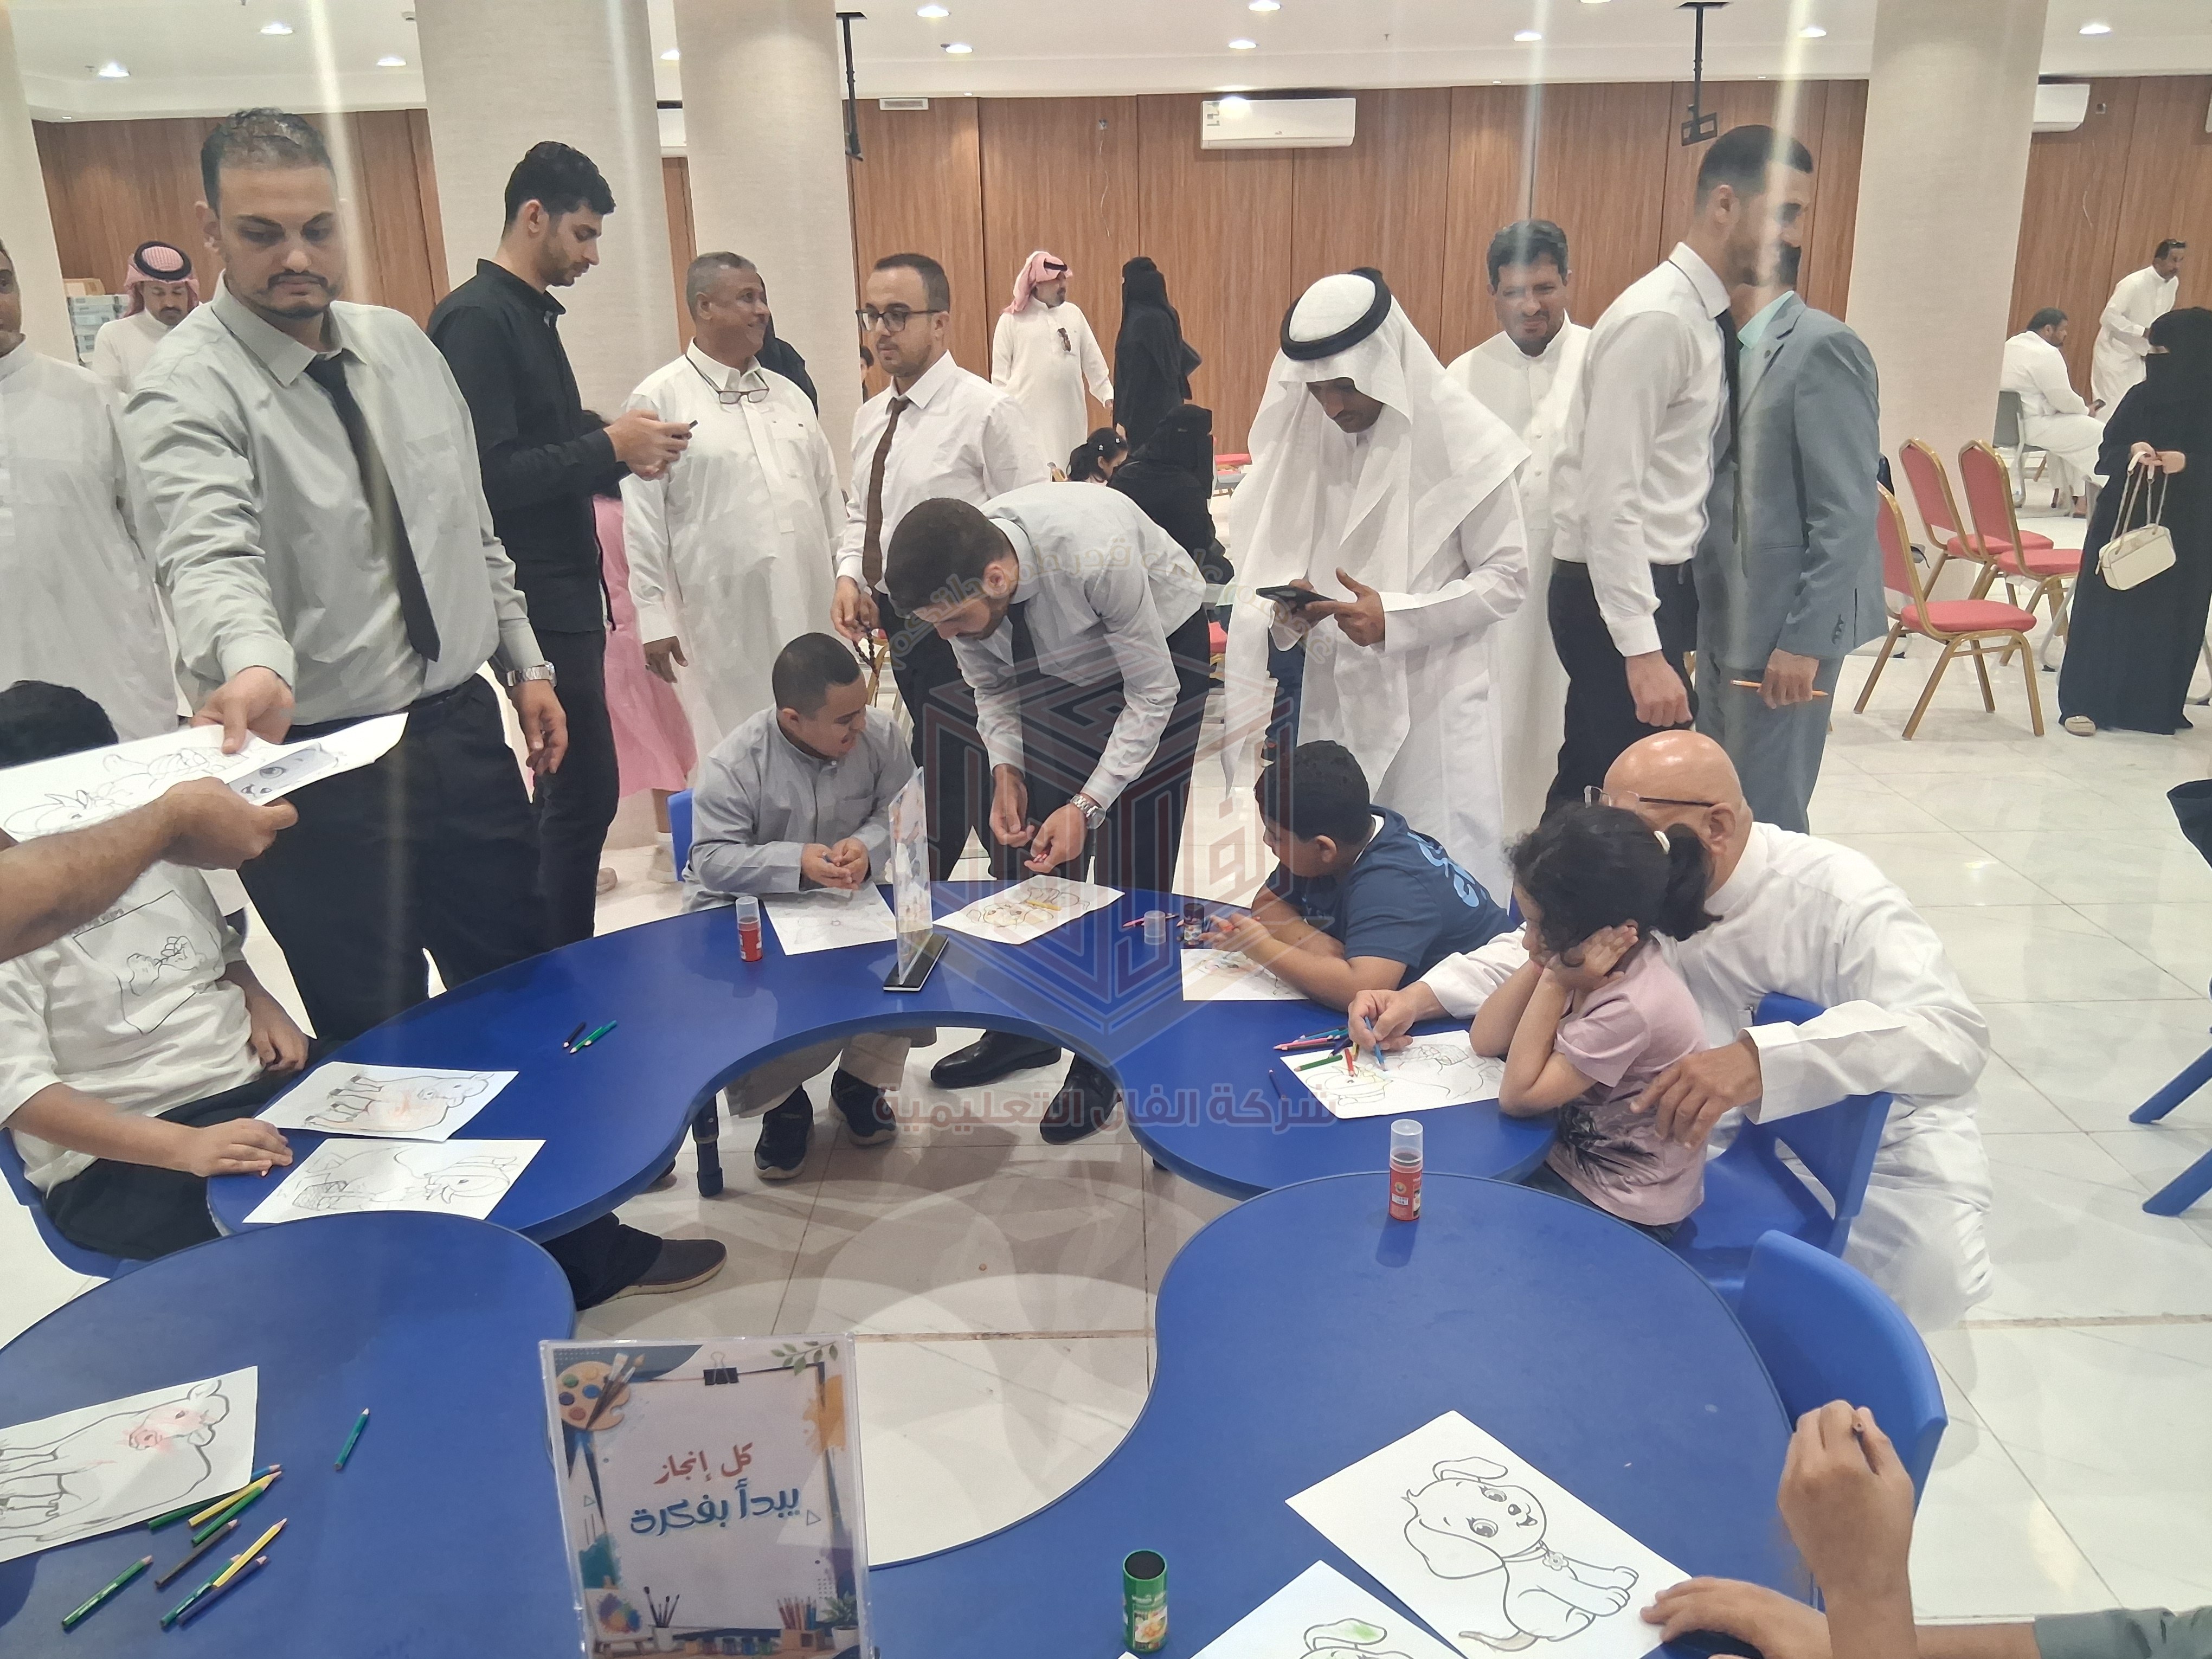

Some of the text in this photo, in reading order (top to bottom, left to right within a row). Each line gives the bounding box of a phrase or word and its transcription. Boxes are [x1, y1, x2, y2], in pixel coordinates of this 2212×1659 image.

[653, 1442, 753, 1484] كل إنجاز
[630, 1478, 800, 1536] يبدأ بفكرة
